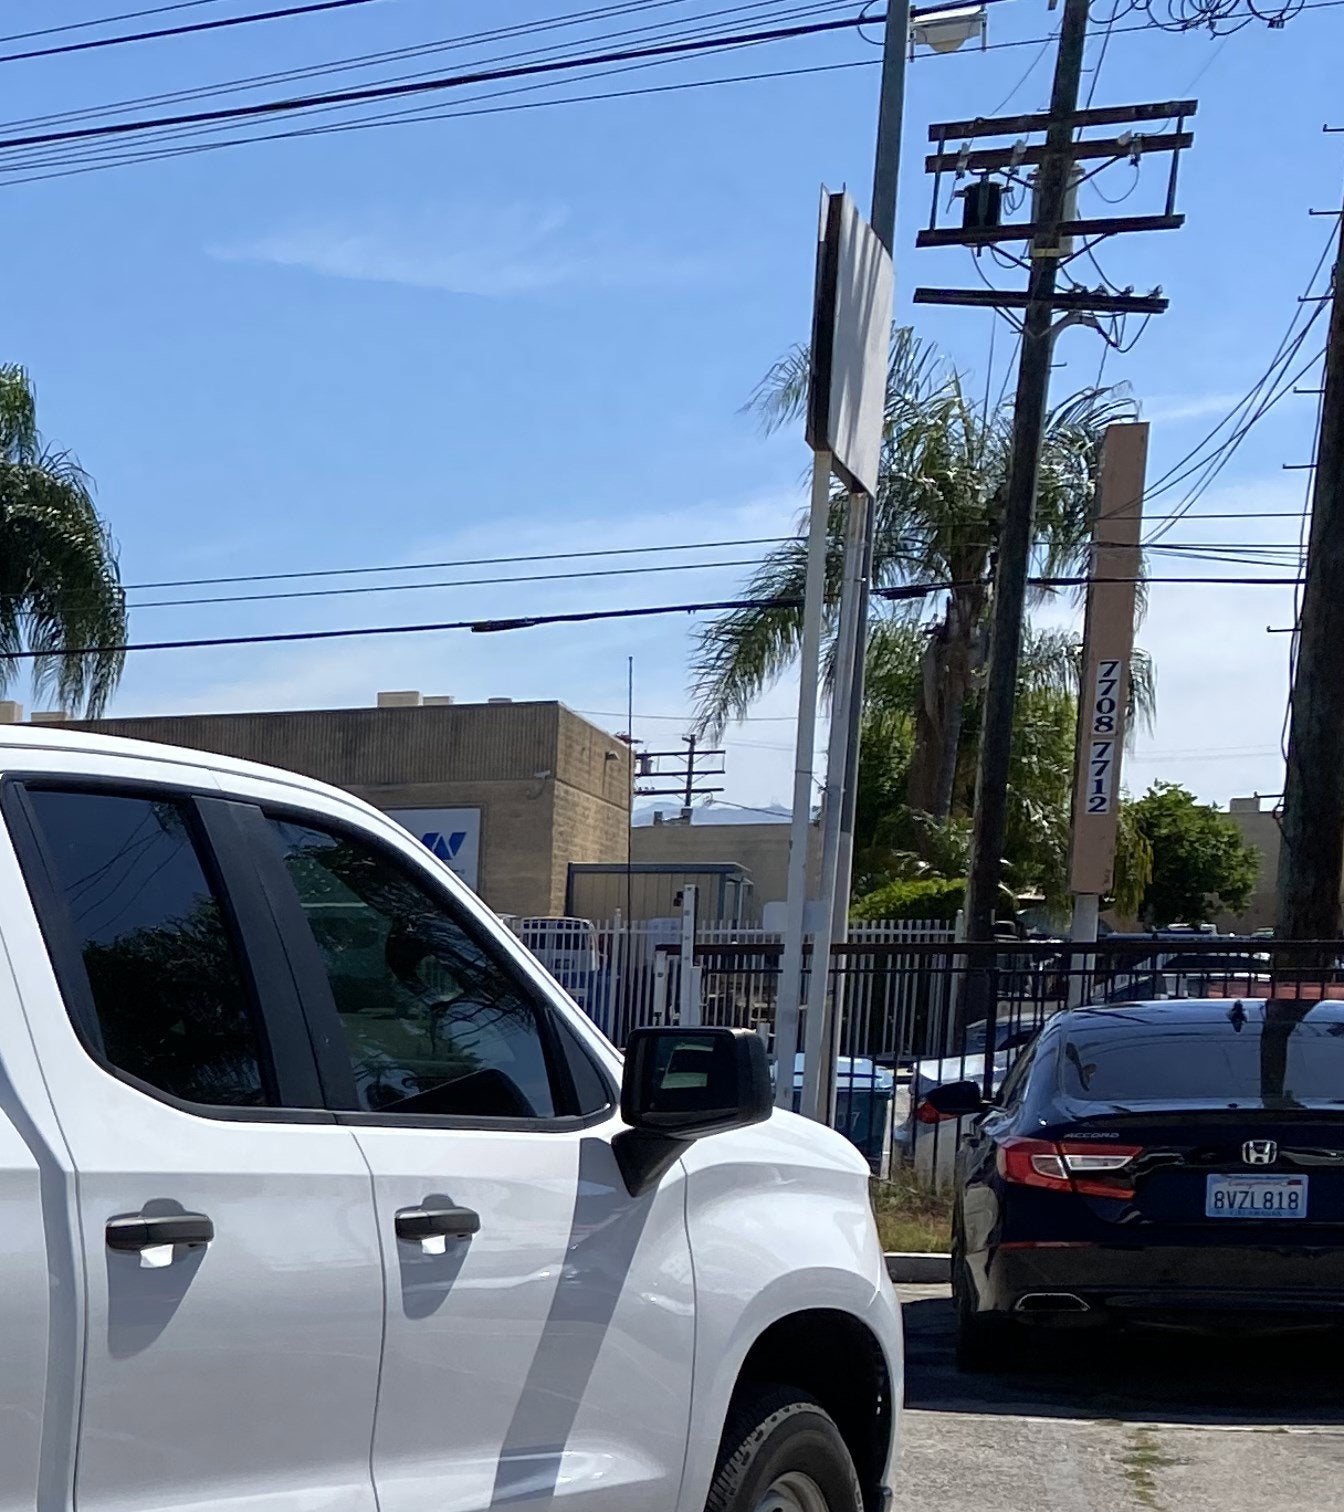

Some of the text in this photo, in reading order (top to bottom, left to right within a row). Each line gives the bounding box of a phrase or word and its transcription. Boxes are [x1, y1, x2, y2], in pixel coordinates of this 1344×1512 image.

[1094, 661, 1119, 733] 7708
[1088, 742, 1112, 813] 7712
[1214, 1190, 1299, 1210] 8VZL818
